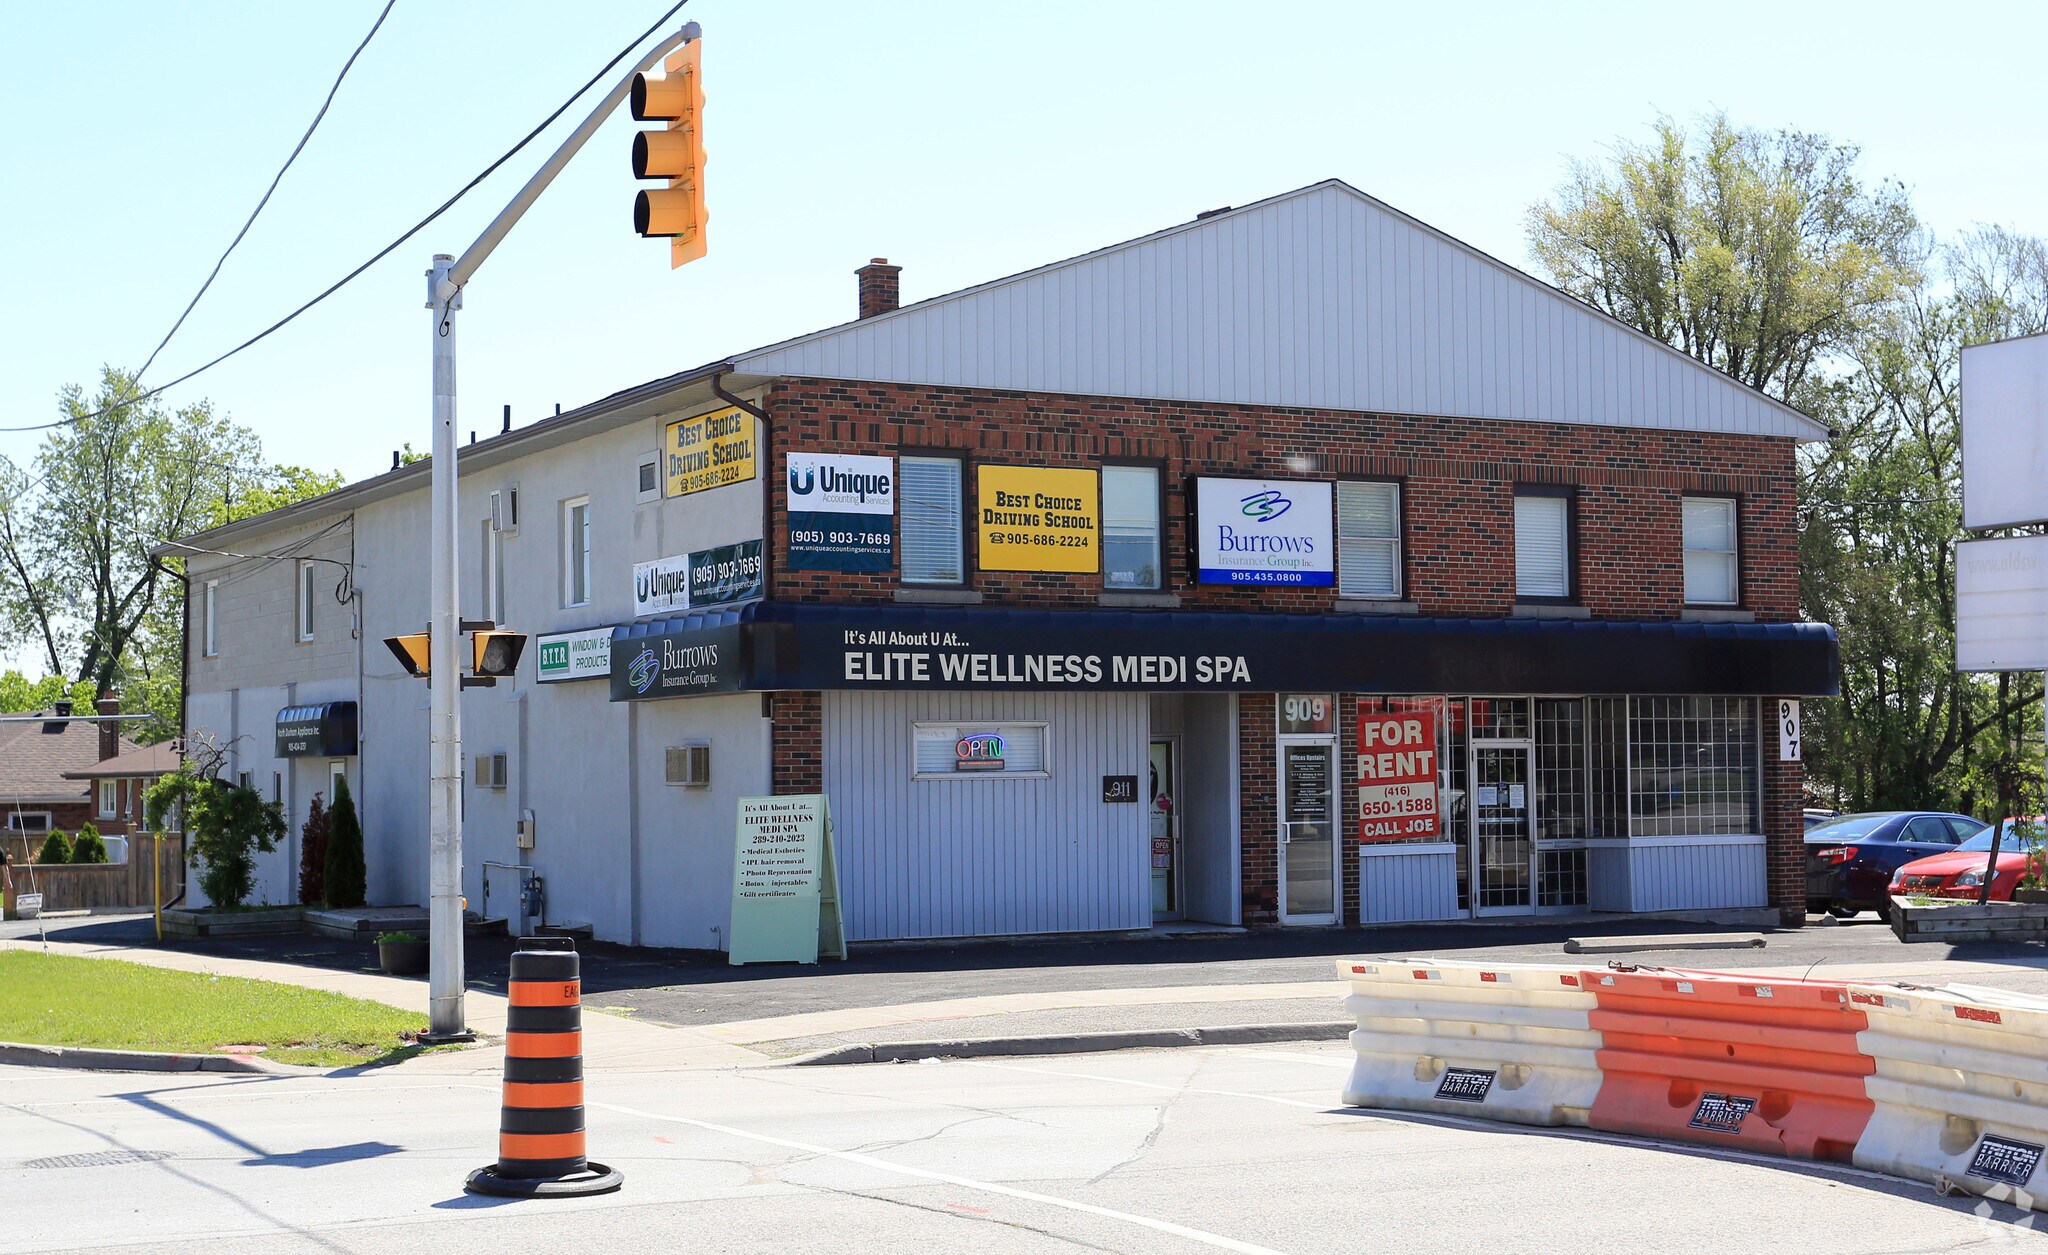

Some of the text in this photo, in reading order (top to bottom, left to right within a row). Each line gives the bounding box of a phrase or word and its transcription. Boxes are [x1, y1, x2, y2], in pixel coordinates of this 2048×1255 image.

[678, 412, 741, 447] BEST CHOICE
[669, 439, 751, 477] DRIVING SCHOOL
[690, 466, 739, 489] 905-686-2224
[820, 466, 889, 503] Unique
[823, 493, 890, 506] Accounting Services
[996, 491, 1082, 511] BEST CHOICE
[983, 508, 1093, 530] DRIVING SCHOOL
[791, 531, 891, 545] (905) 903-7669
[1007, 533, 1088, 548] 905-686-2224
[1218, 525, 1314, 553] Burrows
[790, 545, 890, 554] www.uniqueaccountingservices.ca
[1218, 554, 1314, 569] Insurance Group Inc.
[693, 564, 716, 585] (905)
[1231, 572, 1301, 582] 905.435.0800
[651, 566, 685, 605] Unique
[572, 638, 598, 652] WINDOW
[868, 631, 886, 646] All
[889, 631, 928, 646] About
[931, 632, 940, 647] U
[942, 633, 969, 647] At...
[542, 647, 567, 665] B.T.T.R.
[576, 655, 608, 669] PRODUCTS
[663, 638, 718, 671] Burrows
[844, 652, 1252, 683] ELITE WELLNESS MEDI SPA
[662, 671, 689, 688] Insurance
[690, 670, 709, 687] Group
[1285, 698, 1325, 722] 909
[1364, 719, 1423, 747] FOR
[1781, 702, 1798, 758] 907
[956, 740, 1002, 758] OPEN
[1358, 750, 1433, 780] RENT
[1113, 781, 1130, 797] 911
[1384, 785, 1411, 798] (416)
[771, 803, 790, 811] About
[1362, 798, 1433, 816] 650-1588
[745, 814, 814, 824] ELITE WELLNESS
[1364, 819, 1434, 837] CALL JOE
[760, 824, 798, 833] MEDI SPA
[774, 846, 805, 854] Esthetics
[776, 857, 805, 865] removal
[767, 868, 813, 877] Rejuvenation
[771, 879, 808, 888] injectables
[1446, 1072, 1492, 1085] TRITON
[1441, 1082, 1487, 1095] BARRIER
[1981, 1140, 2040, 1164] TRITON
[1975, 1153, 2032, 1177] BARRIER
